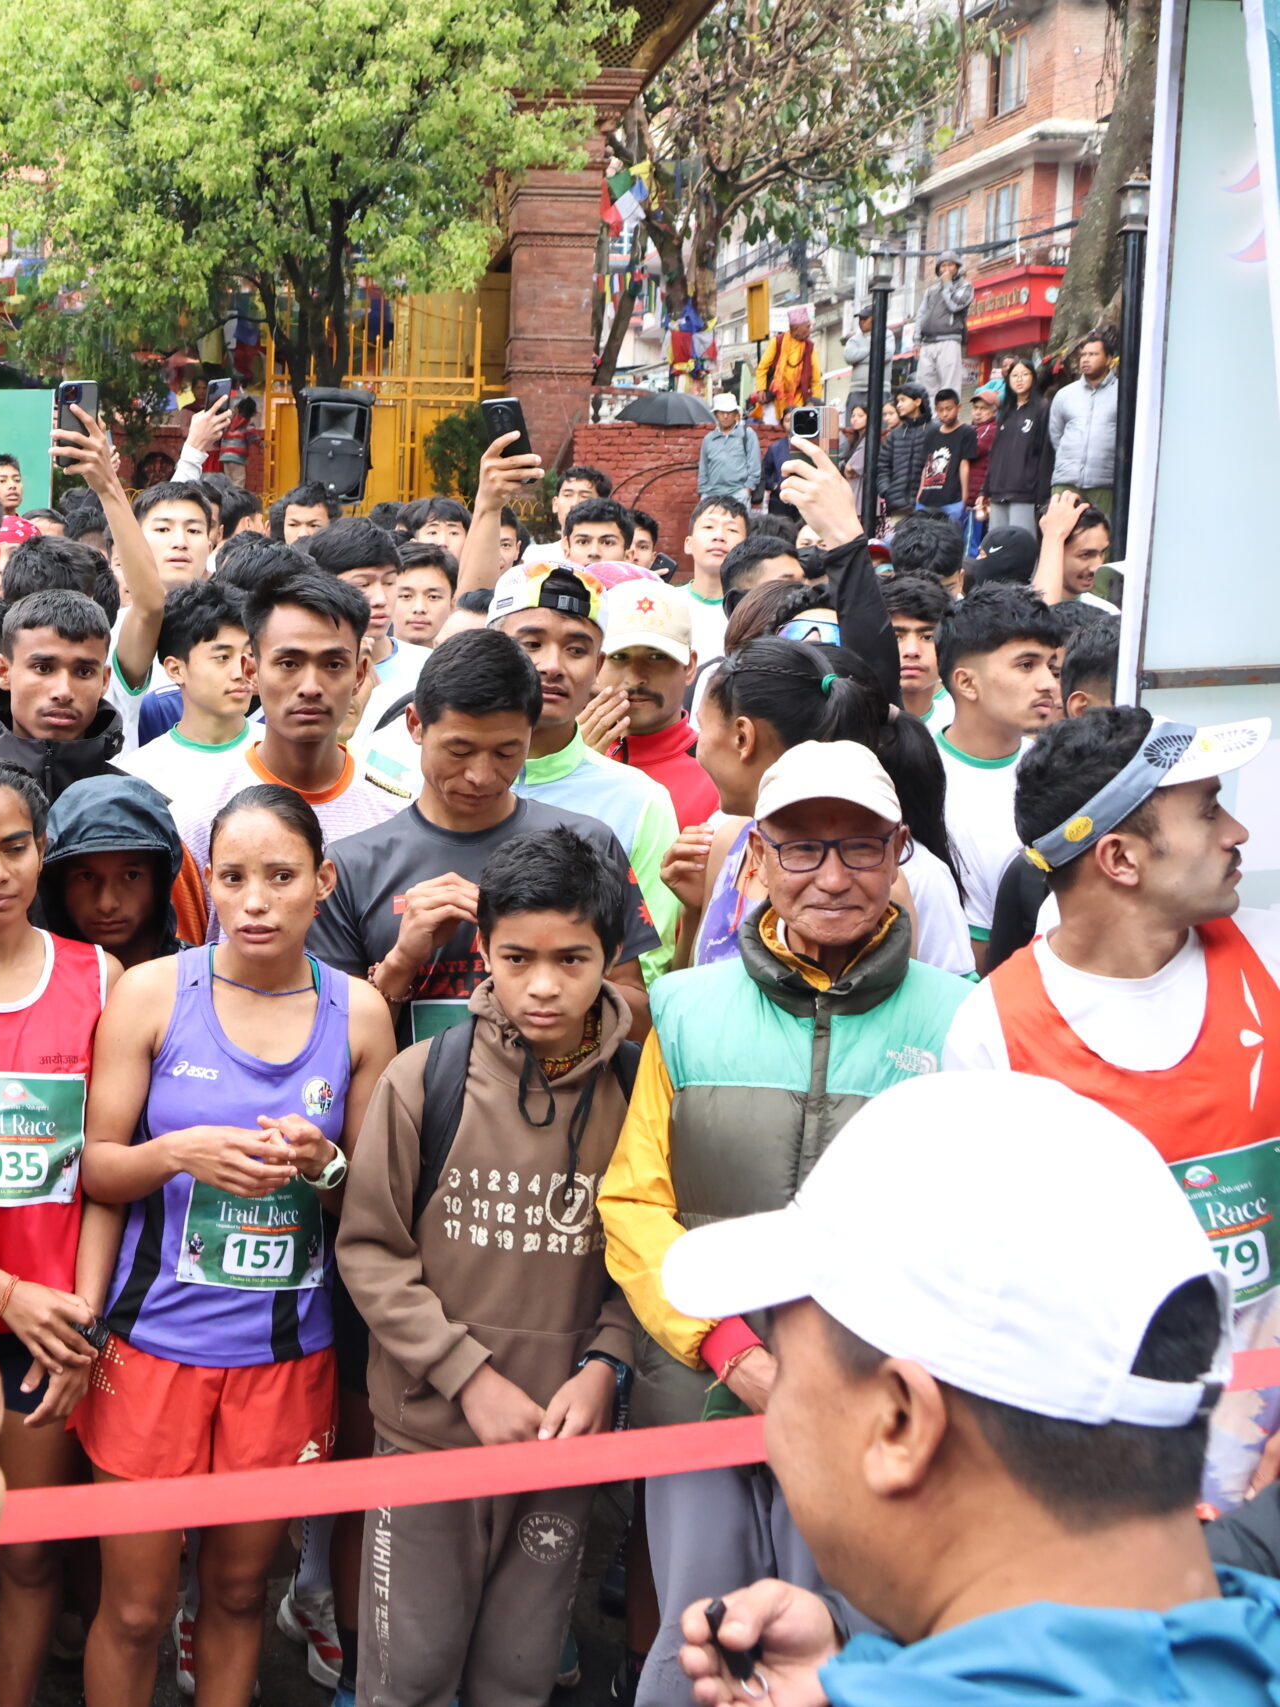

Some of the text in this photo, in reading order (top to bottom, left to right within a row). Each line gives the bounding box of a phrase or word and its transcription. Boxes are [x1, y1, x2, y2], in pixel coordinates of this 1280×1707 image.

[12, 1113, 56, 1136] Race
[469, 1169, 479, 1189] 1
[488, 1170, 501, 1192] 2
[507, 1172, 519, 1194] 3
[528, 1174, 541, 1195] 4
[217, 1201, 299, 1226] Trail Race
[443, 1195, 462, 1215] 10
[472, 1198, 489, 1220] 11
[496, 1202, 516, 1223] 12
[1206, 1197, 1267, 1228] Race
[444, 1219, 461, 1240] 17
[469, 1224, 488, 1246] 18
[495, 1230, 513, 1250] 19
[547, 1233, 568, 1254] 21
[232, 1238, 289, 1269] 157
[1213, 1239, 1260, 1277] 79
